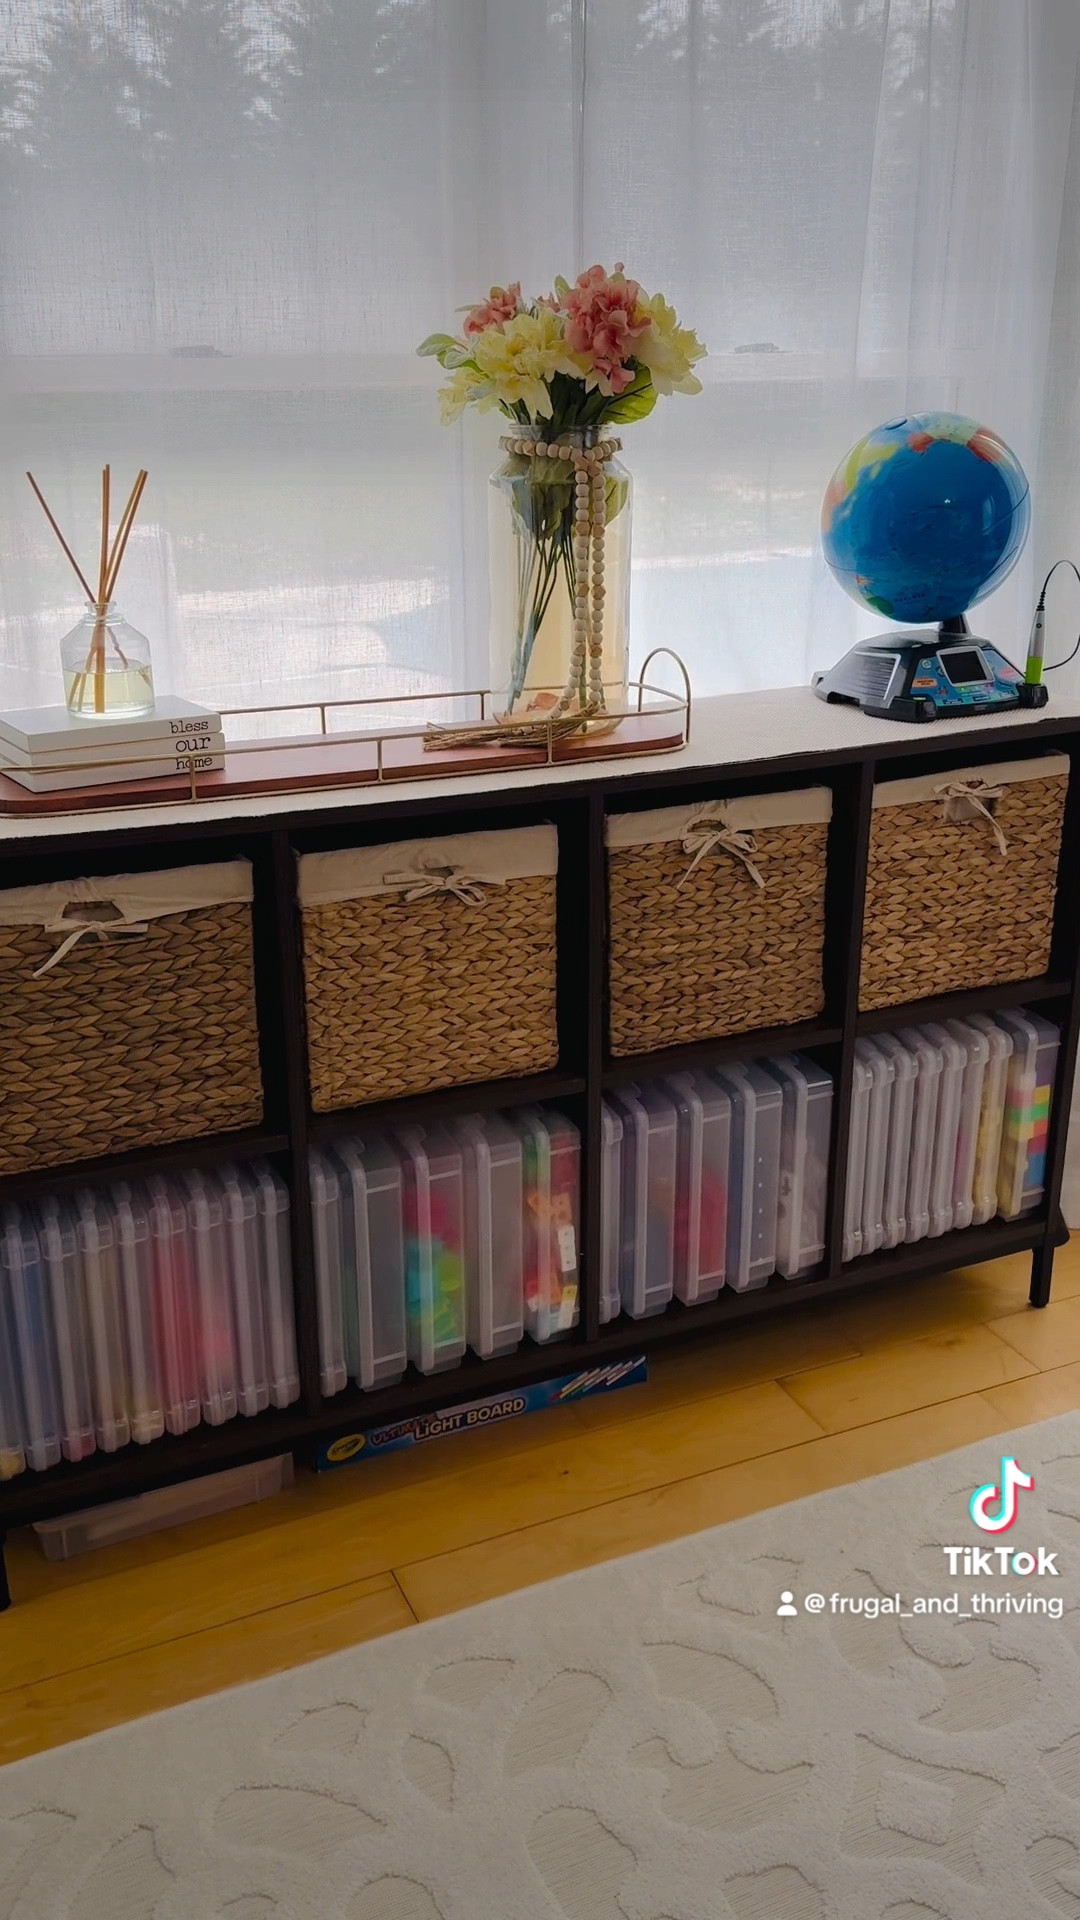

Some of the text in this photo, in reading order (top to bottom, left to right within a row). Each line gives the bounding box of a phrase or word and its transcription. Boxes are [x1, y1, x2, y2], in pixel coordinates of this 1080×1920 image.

[169, 720, 209, 734] bless
[175, 736, 211, 752] our
[175, 757, 213, 770] home
[466, 1397, 526, 1425] BOARD
